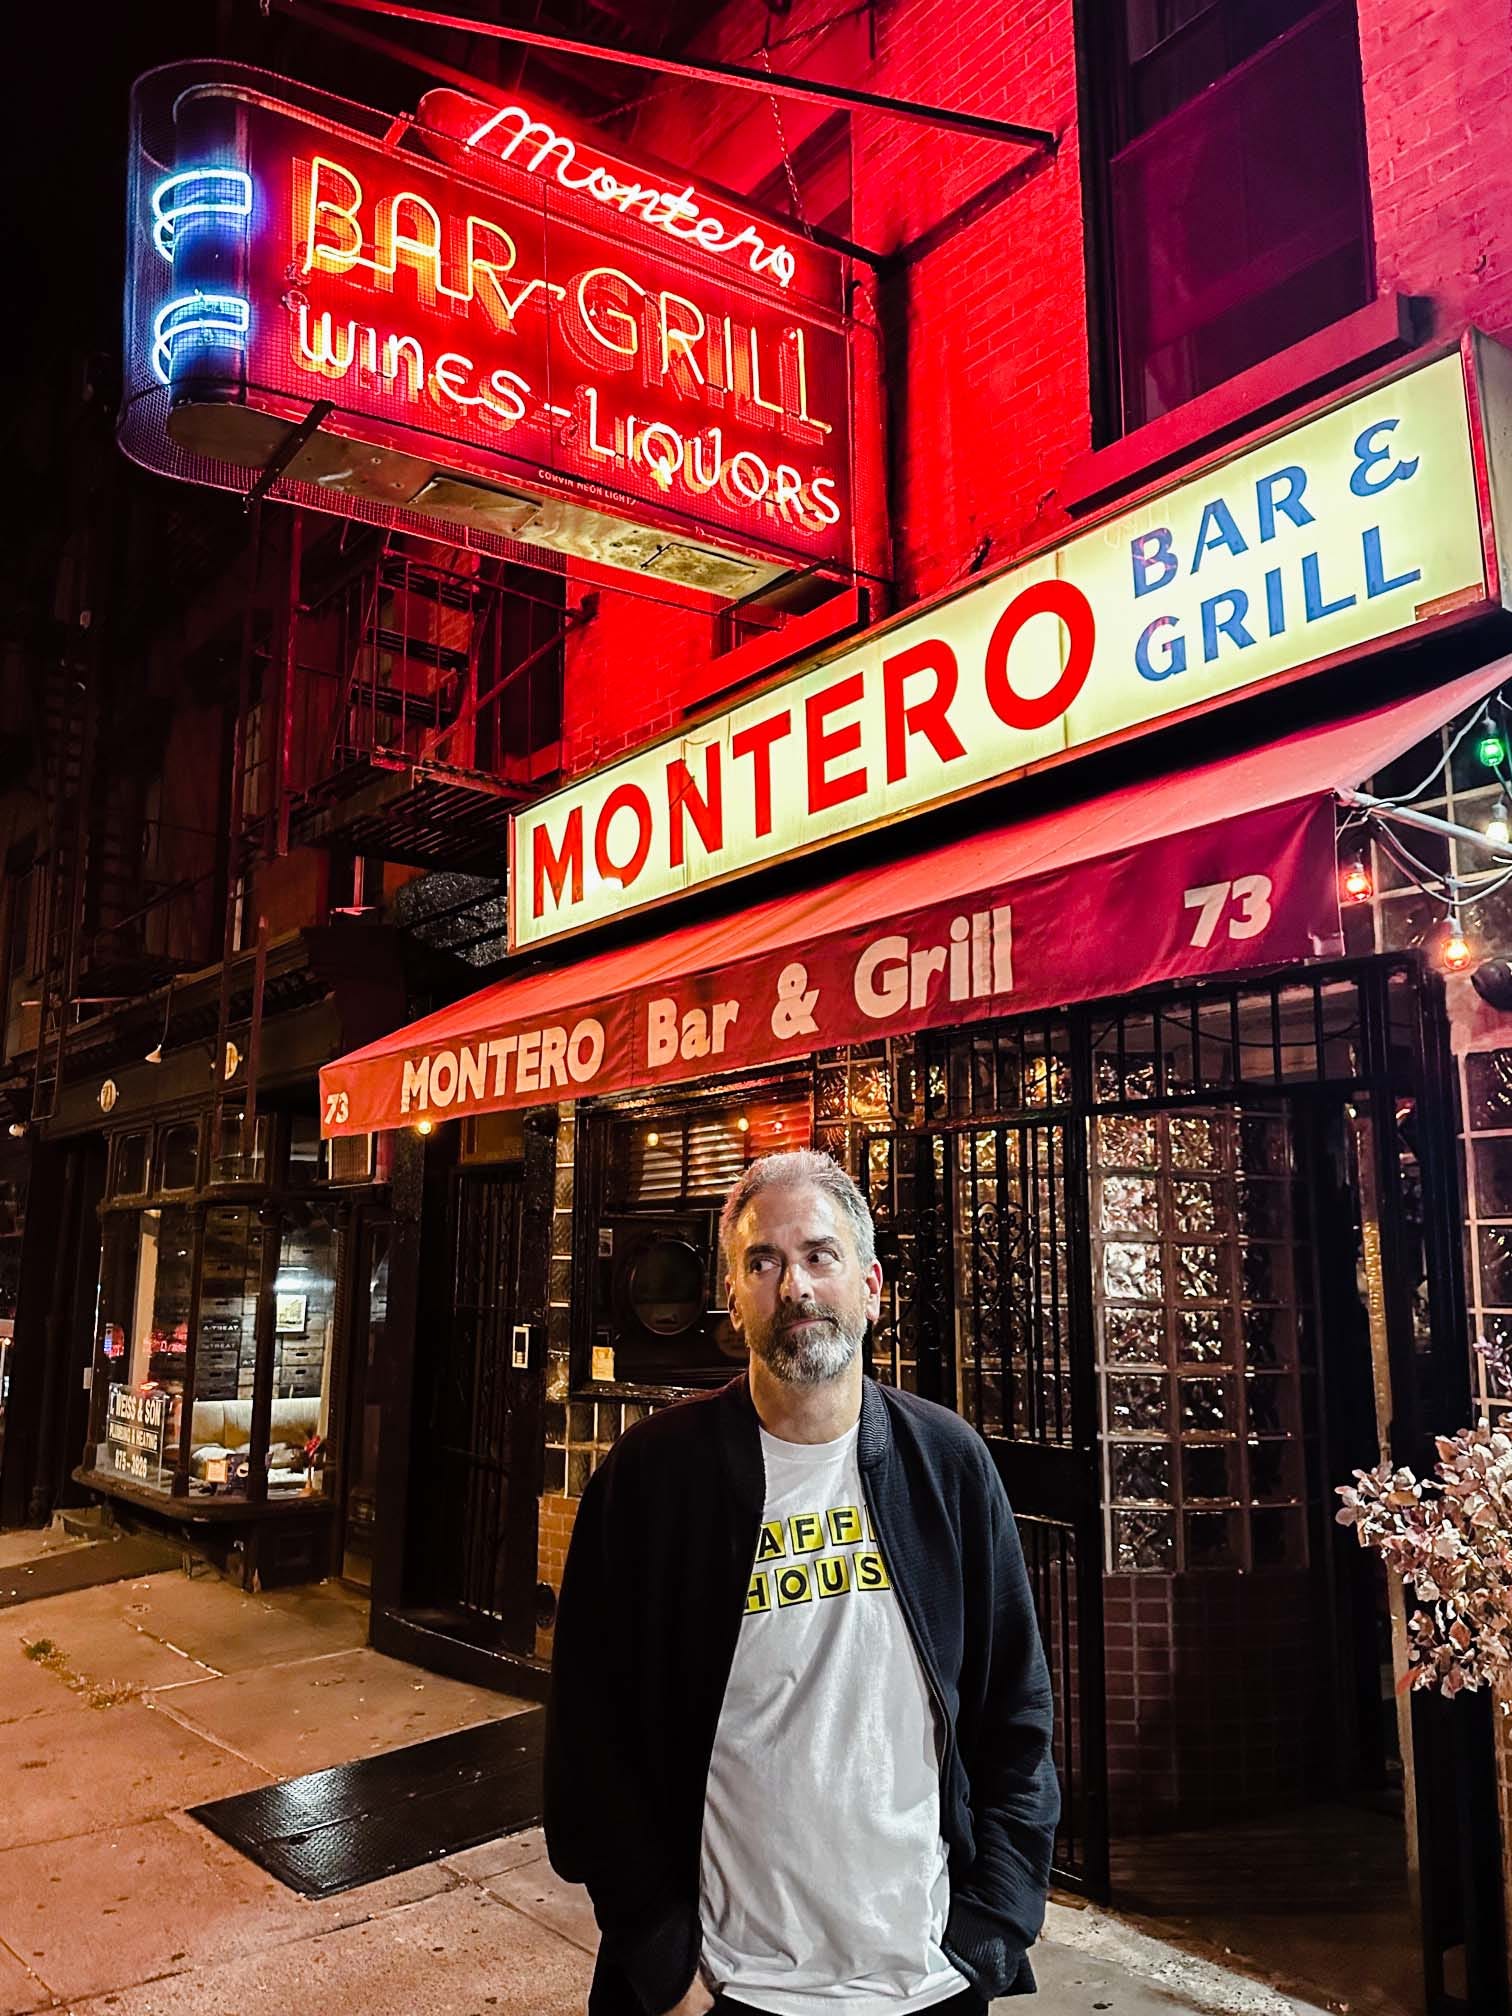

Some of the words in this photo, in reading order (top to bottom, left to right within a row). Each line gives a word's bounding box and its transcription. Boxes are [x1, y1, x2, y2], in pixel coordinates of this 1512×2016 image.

[466, 105, 796, 288] Montero
[577, 482, 602, 496] NEON
[1131, 464, 1315, 598] BAR
[1349, 418, 1420, 497] &
[1135, 526, 1421, 681] GRILL
[532, 579, 1096, 918] MONTERO
[324, 1091, 349, 1125] 73
[400, 1018, 606, 1113] MONTERO
[648, 998, 739, 1068] Bar
[771, 962, 820, 1039] &
[854, 905, 1014, 1018] Grill
[1184, 875, 1271, 948] 73
[115, 1394, 137, 1420] WEISS
[144, 1399, 161, 1427] SON
[757, 1510, 876, 1559] AFF
